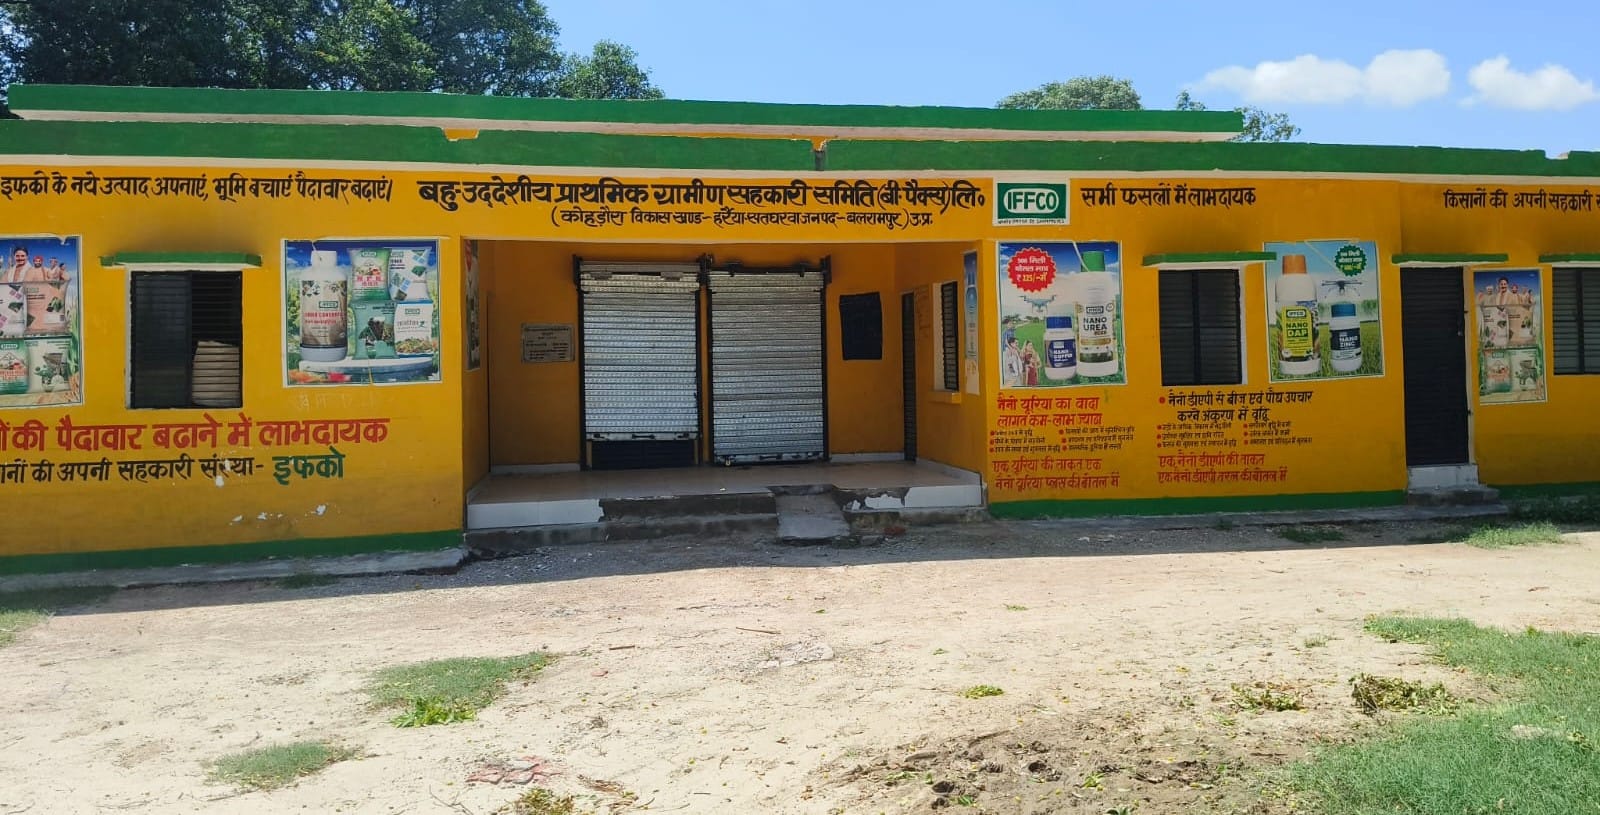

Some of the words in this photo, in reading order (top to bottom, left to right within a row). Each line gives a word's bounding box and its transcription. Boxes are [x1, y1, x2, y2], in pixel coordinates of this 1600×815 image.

[1, 170, 50, 200] इफको
[51, 171, 67, 195] के
[71, 171, 100, 196] नये
[100, 176, 152, 198] उत्पाद
[213, 172, 248, 203] भूमि
[249, 174, 294, 199] बचाएं
[295, 171, 351, 205] पैदावार
[554, 177, 649, 204] प्राथमिक
[651, 178, 726, 206] ग्रामीण
[727, 179, 813, 207] सहकारी
[813, 178, 877, 208] समिति
[1080, 182, 1118, 208] सभी
[1120, 182, 1172, 207] फसलों
[1190, 187, 1257, 210] लाभदायक
[1007, 191, 1058, 212] IFFCO
[1443, 187, 1487, 210] किसानों
[1489, 188, 1508, 209] की
[1512, 188, 1547, 209] अपनी
[1548, 189, 1593, 212] सहकारी
[631, 206, 672, 225] विकास
[1287, 329, 1308, 337] DAP
[1020, 395, 1053, 415] यूरिया
[1055, 398, 1073, 409] का
[1076, 397, 1100, 410] वादा
[1286, 391, 1313, 404] उपचार
[997, 414, 1027, 427] लागत
[12, 419, 48, 451] की
[56, 415, 147, 451] पैदावार
[227, 412, 252, 447] में
[256, 418, 390, 446] लाभदायक
[31, 459, 54, 482] की
[57, 457, 112, 482] अपनी
[117, 453, 194, 483] सहकारी
[272, 446, 346, 486] इफको
[992, 460, 1009, 472] एक
[1040, 456, 1053, 471] की
